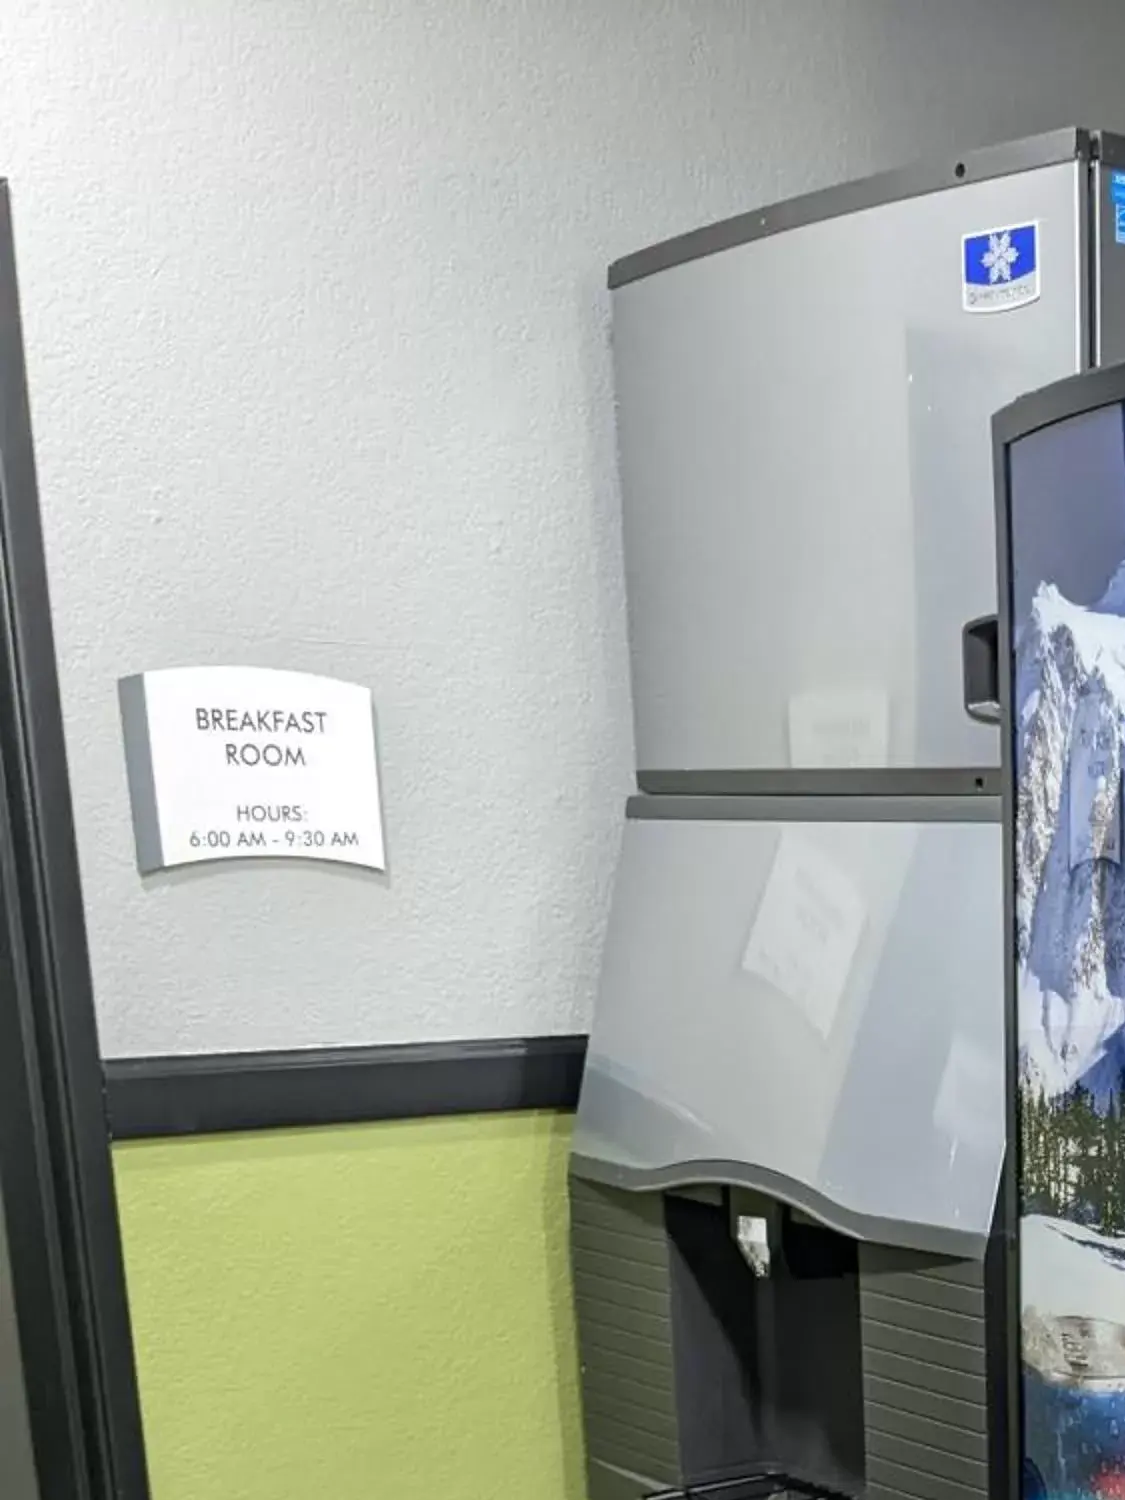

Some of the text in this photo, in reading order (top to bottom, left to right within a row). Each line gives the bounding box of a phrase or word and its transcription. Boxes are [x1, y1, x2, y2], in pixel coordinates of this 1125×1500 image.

[195, 707, 327, 733] BREAKFAST
[225, 743, 306, 767] ROOM
[236, 805, 308, 822] HOURS:
[189, 830, 231, 848] 6:00
[237, 831, 267, 847] AM
[285, 830, 325, 848] 9:30
[331, 831, 359, 846] AM
